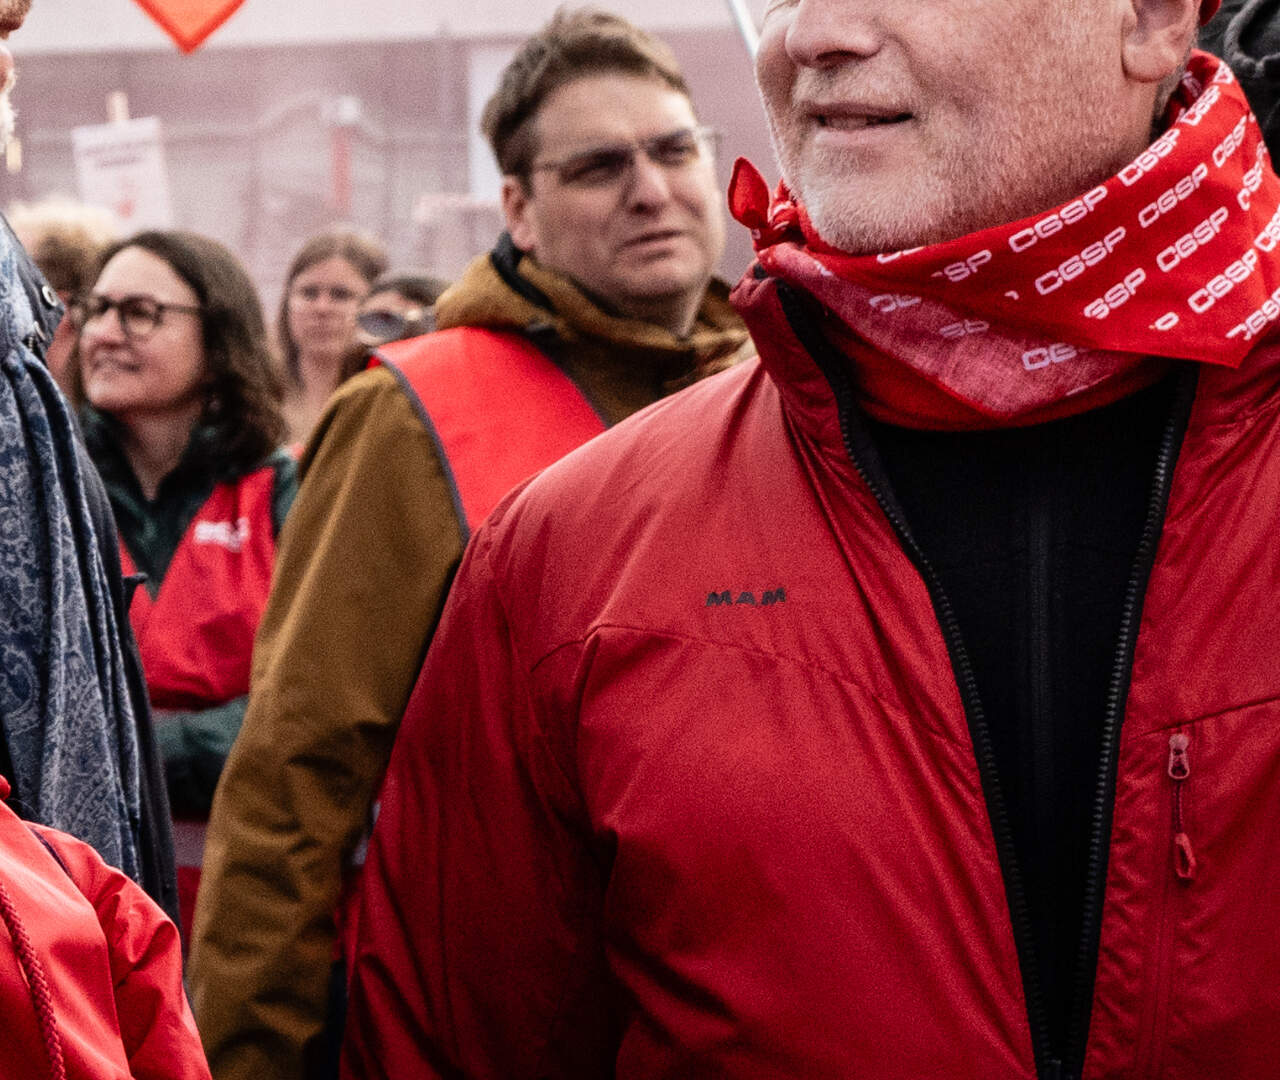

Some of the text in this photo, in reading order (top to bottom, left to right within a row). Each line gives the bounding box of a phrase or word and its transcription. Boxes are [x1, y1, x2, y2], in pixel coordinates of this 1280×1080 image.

[1008, 185, 1108, 253] CGSP
[1117, 128, 1181, 187] CGSP
[1035, 226, 1127, 296] CGSP
[1138, 162, 1209, 228] CGSP
[1156, 206, 1229, 272] CGSP
[1188, 249, 1259, 314] CGSP
